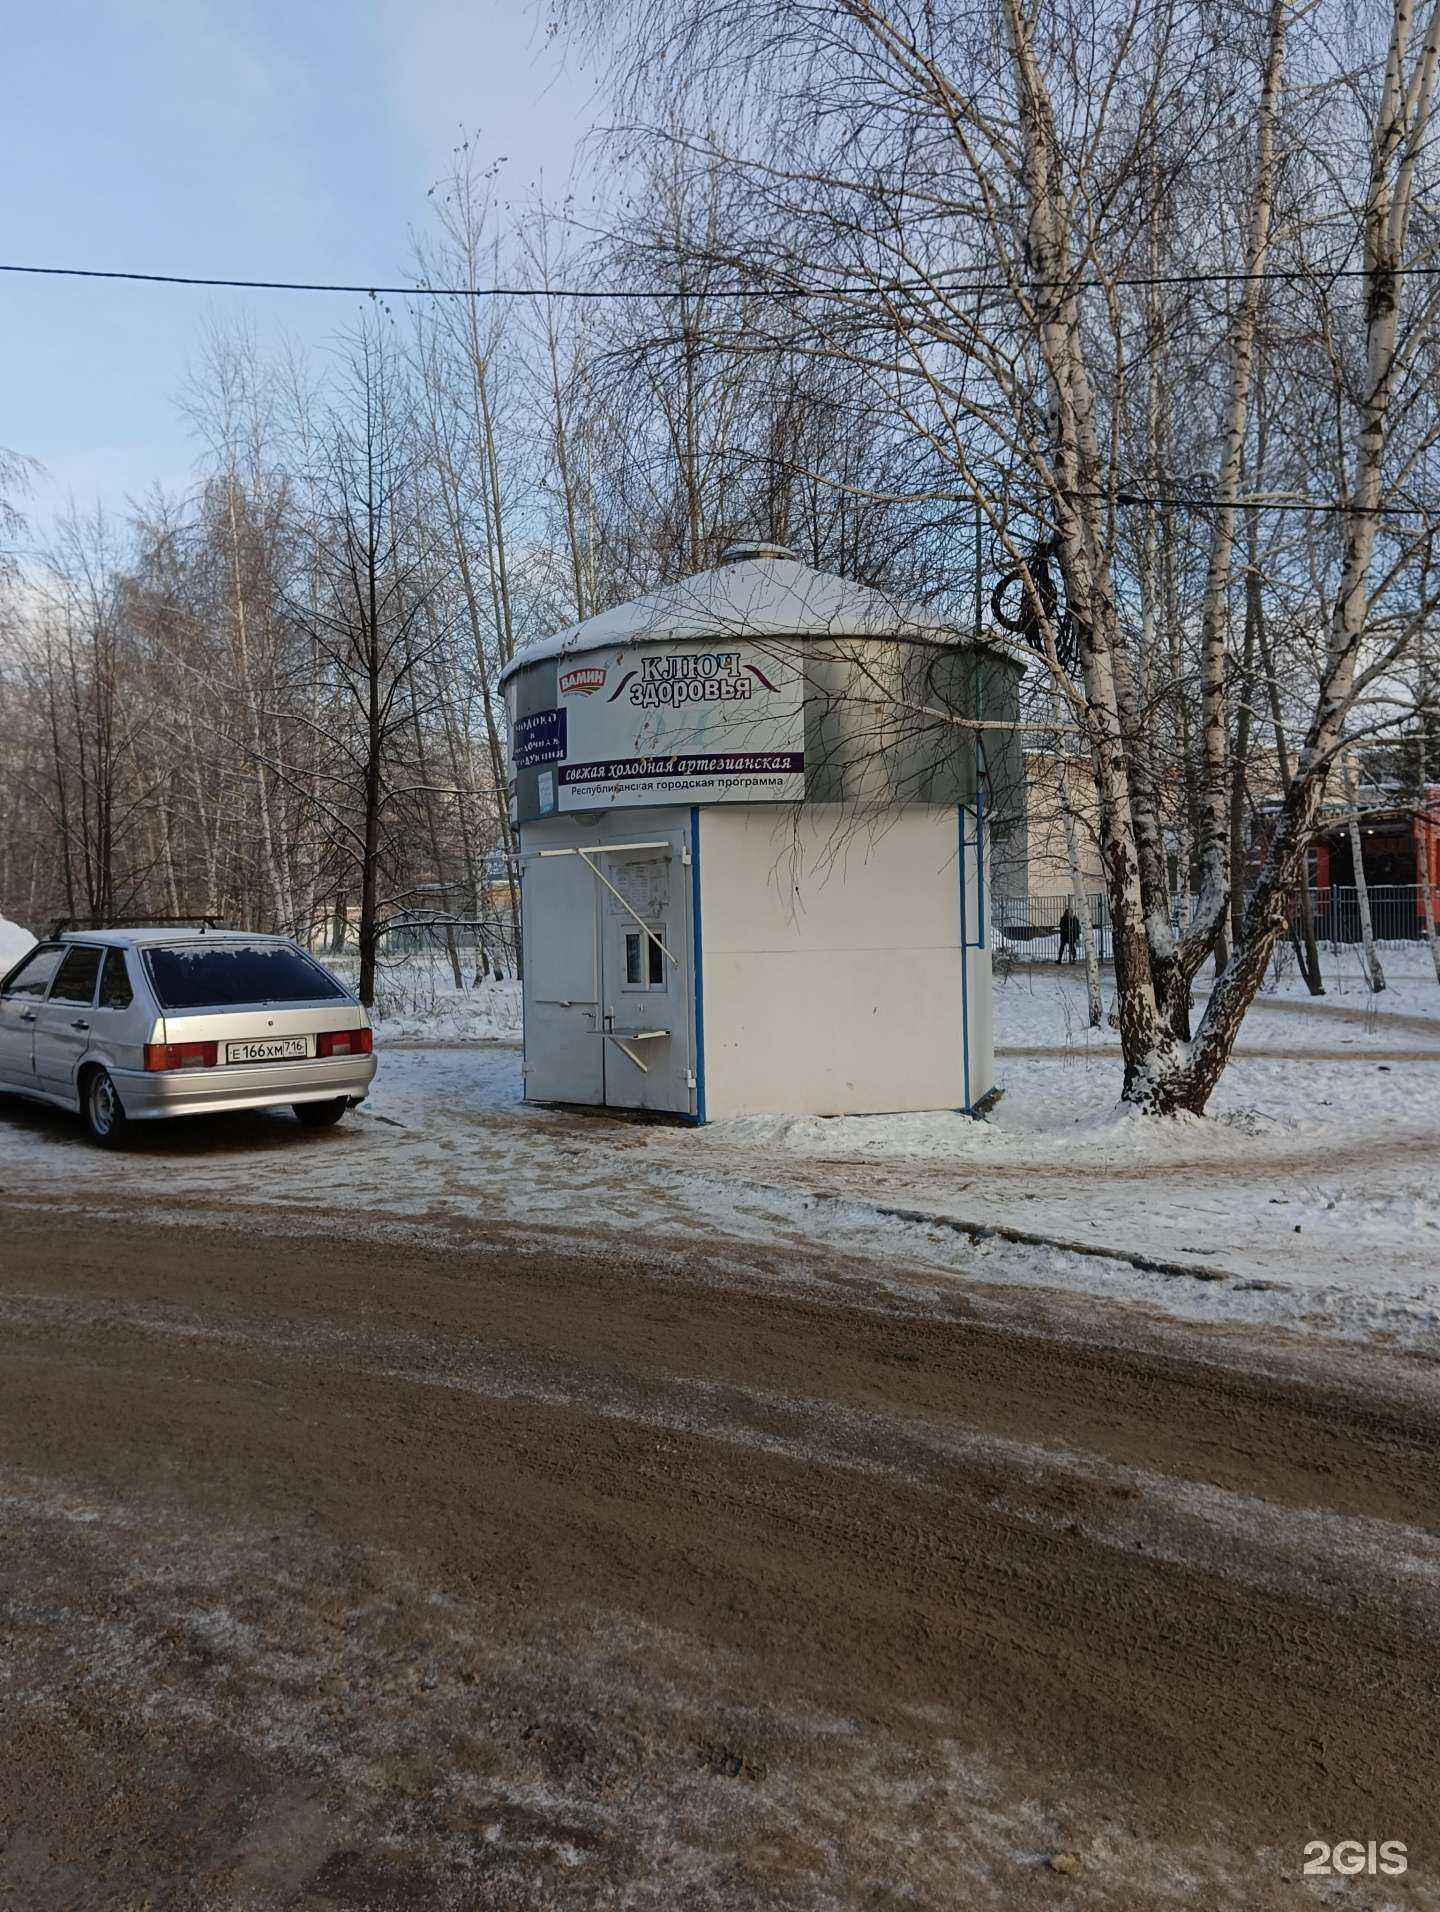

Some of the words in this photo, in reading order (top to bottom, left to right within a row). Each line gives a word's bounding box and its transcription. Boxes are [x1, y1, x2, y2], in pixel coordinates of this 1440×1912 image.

[642, 653, 741, 682] КЛЮЧ
[562, 670, 604, 690] ВАМИН
[565, 766, 606, 781] свежая
[608, 758, 674, 778] холодная
[678, 757, 792, 775] артезианская
[656, 779, 714, 791] городская
[718, 777, 784, 788] программа
[284, 1041, 303, 1051] 716
